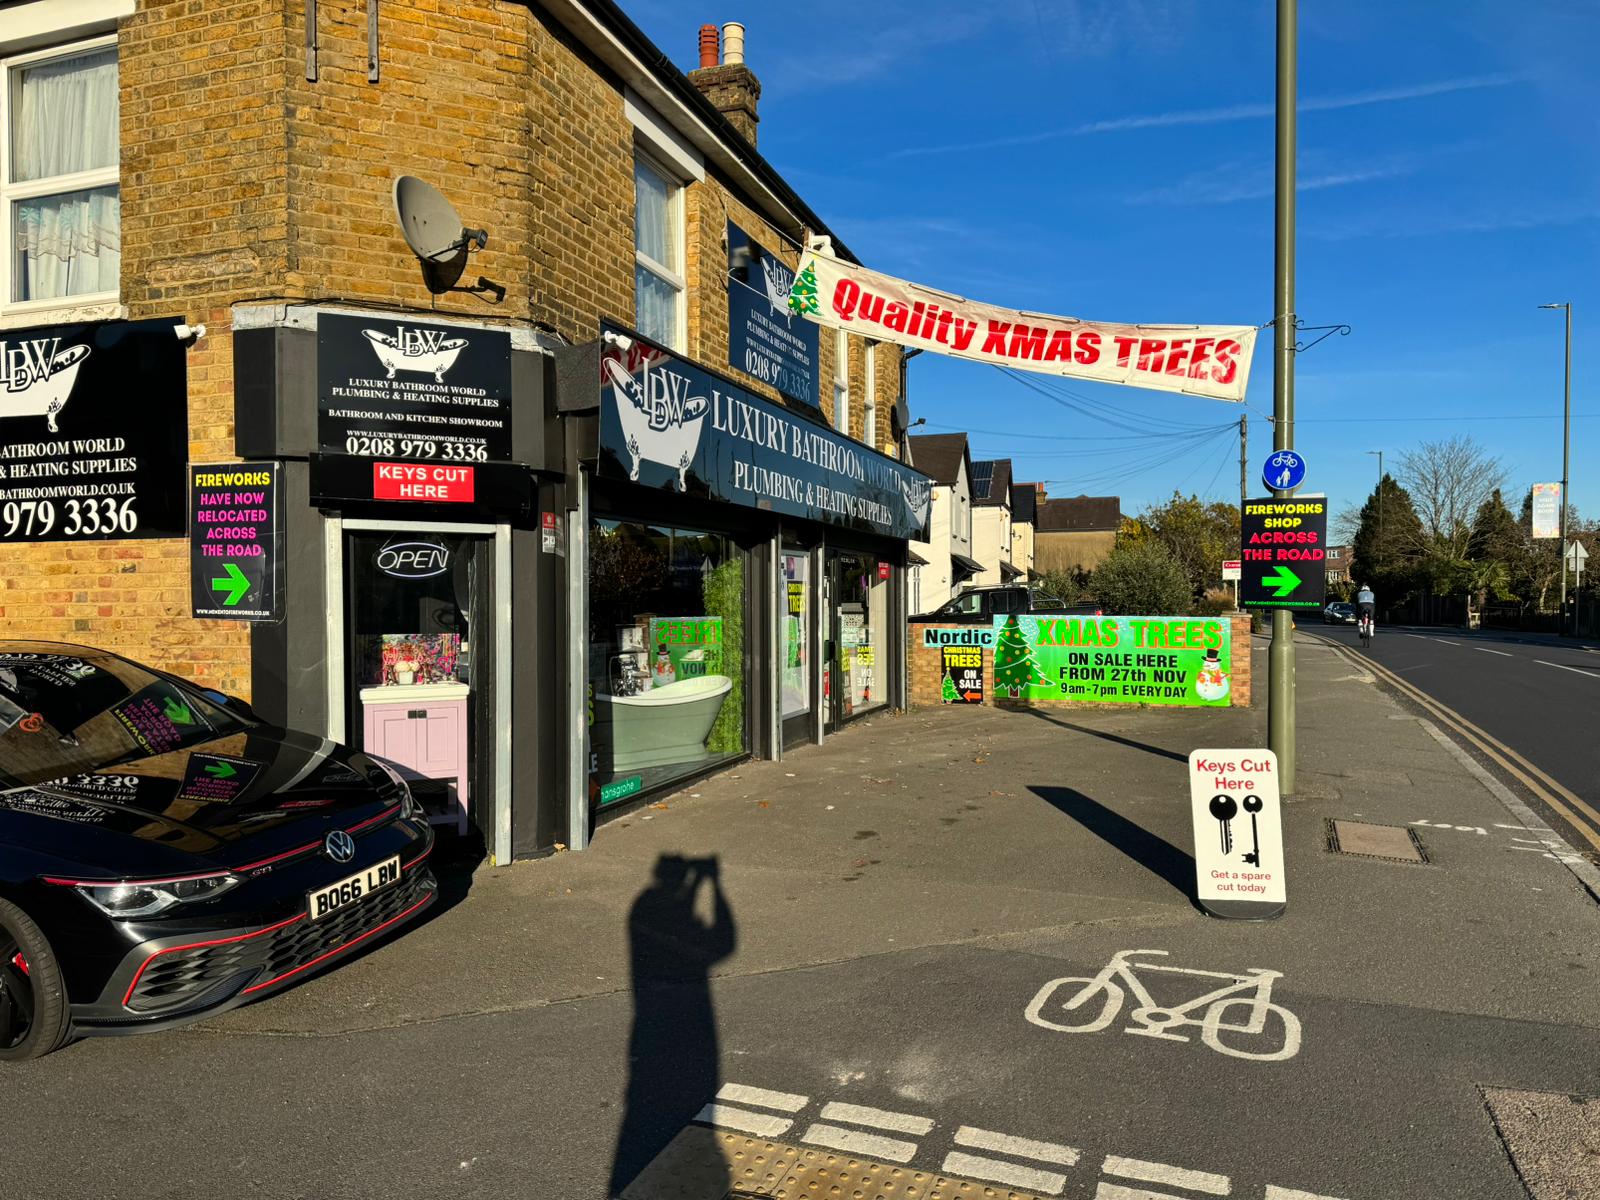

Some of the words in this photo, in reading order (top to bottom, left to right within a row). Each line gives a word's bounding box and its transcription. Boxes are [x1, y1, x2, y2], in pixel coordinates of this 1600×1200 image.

[832, 278, 978, 351] Quality
[981, 319, 1103, 365] XMAS
[1114, 336, 1243, 385] TREES
[745, 348, 770, 382] 0208
[771, 362, 788, 390] 979
[790, 373, 810, 402] 3336
[349, 378, 390, 389] LUXURY
[392, 380, 449, 393] BATHROOM
[450, 386, 486, 397] WORLD
[332, 387, 390, 400] PLUMBING
[392, 391, 400, 400] &
[403, 392, 451, 405] HEATING
[452, 395, 499, 408] SUPPLIES
[328, 409, 383, 420] BATHROOM
[385, 411, 404, 422] AND
[406, 414, 447, 425] KITCHEN
[449, 416, 503, 428] SHOWROOM
[0, 441, 70, 459] ATHROOM
[72, 437, 125, 454] WORLD
[346, 436, 395, 456] 0208
[401, 439, 436, 458] 979
[442, 442, 488, 462] 3336
[712, 389, 789, 455] LUXURY
[792, 425, 865, 482] BATHROOM
[866, 458, 901, 494] WORLD
[10, 461, 69, 479] HEATING
[72, 457, 137, 475] SUPPLIES
[379, 466, 427, 480] KEYS
[433, 468, 468, 482] CUT
[195, 472, 271, 487] FIREWORKS
[200, 493, 231, 505] HAVE
[234, 492, 264, 505] NOW
[400, 484, 448, 498] HERE
[734, 461, 803, 505] PLUMBING
[805, 484, 814, 506] &
[816, 485, 858, 518] HEATING
[858, 498, 893, 527] SUPPLIES
[3, 500, 55, 537] 979
[64, 496, 138, 535] 3336
[198, 510, 267, 523] RELOCATED
[1245, 504, 1323, 516] FIREWORKS
[1264, 517, 1302, 528] SHOP
[206, 526, 256, 539] ACROSS
[1249, 531, 1318, 544] ACROSS
[201, 544, 223, 557] THE
[226, 544, 262, 557] ROAD
[1243, 549, 1272, 561] THE
[1277, 548, 1324, 561] ROAD
[377, 549, 449, 570] OPEN
[925, 629, 992, 645] Nordic
[1035, 618, 1119, 647] XMAS
[1130, 619, 1223, 650] TREES
[943, 646, 981, 655] CHRISTMAS
[944, 654, 982, 668] TREES
[1068, 653, 1089, 667] ON
[1093, 653, 1133, 668] SALE
[1136, 654, 1179, 668] HERE
[964, 670, 977, 680] ON
[1059, 667, 1105, 682] FROM
[1110, 669, 1147, 683] 27th
[1153, 670, 1187, 684] NOV
[959, 678, 982, 690] SALE
[1197, 759, 1236, 775] Keys
[1240, 759, 1271, 772] Cut
[1215, 777, 1255, 790] Here
[367, 860, 397, 892] LBW
[1211, 870, 1229, 879] Get
[1241, 873, 1272, 882] spare
[1217, 883, 1234, 891] cut
[1237, 883, 1266, 893] today
